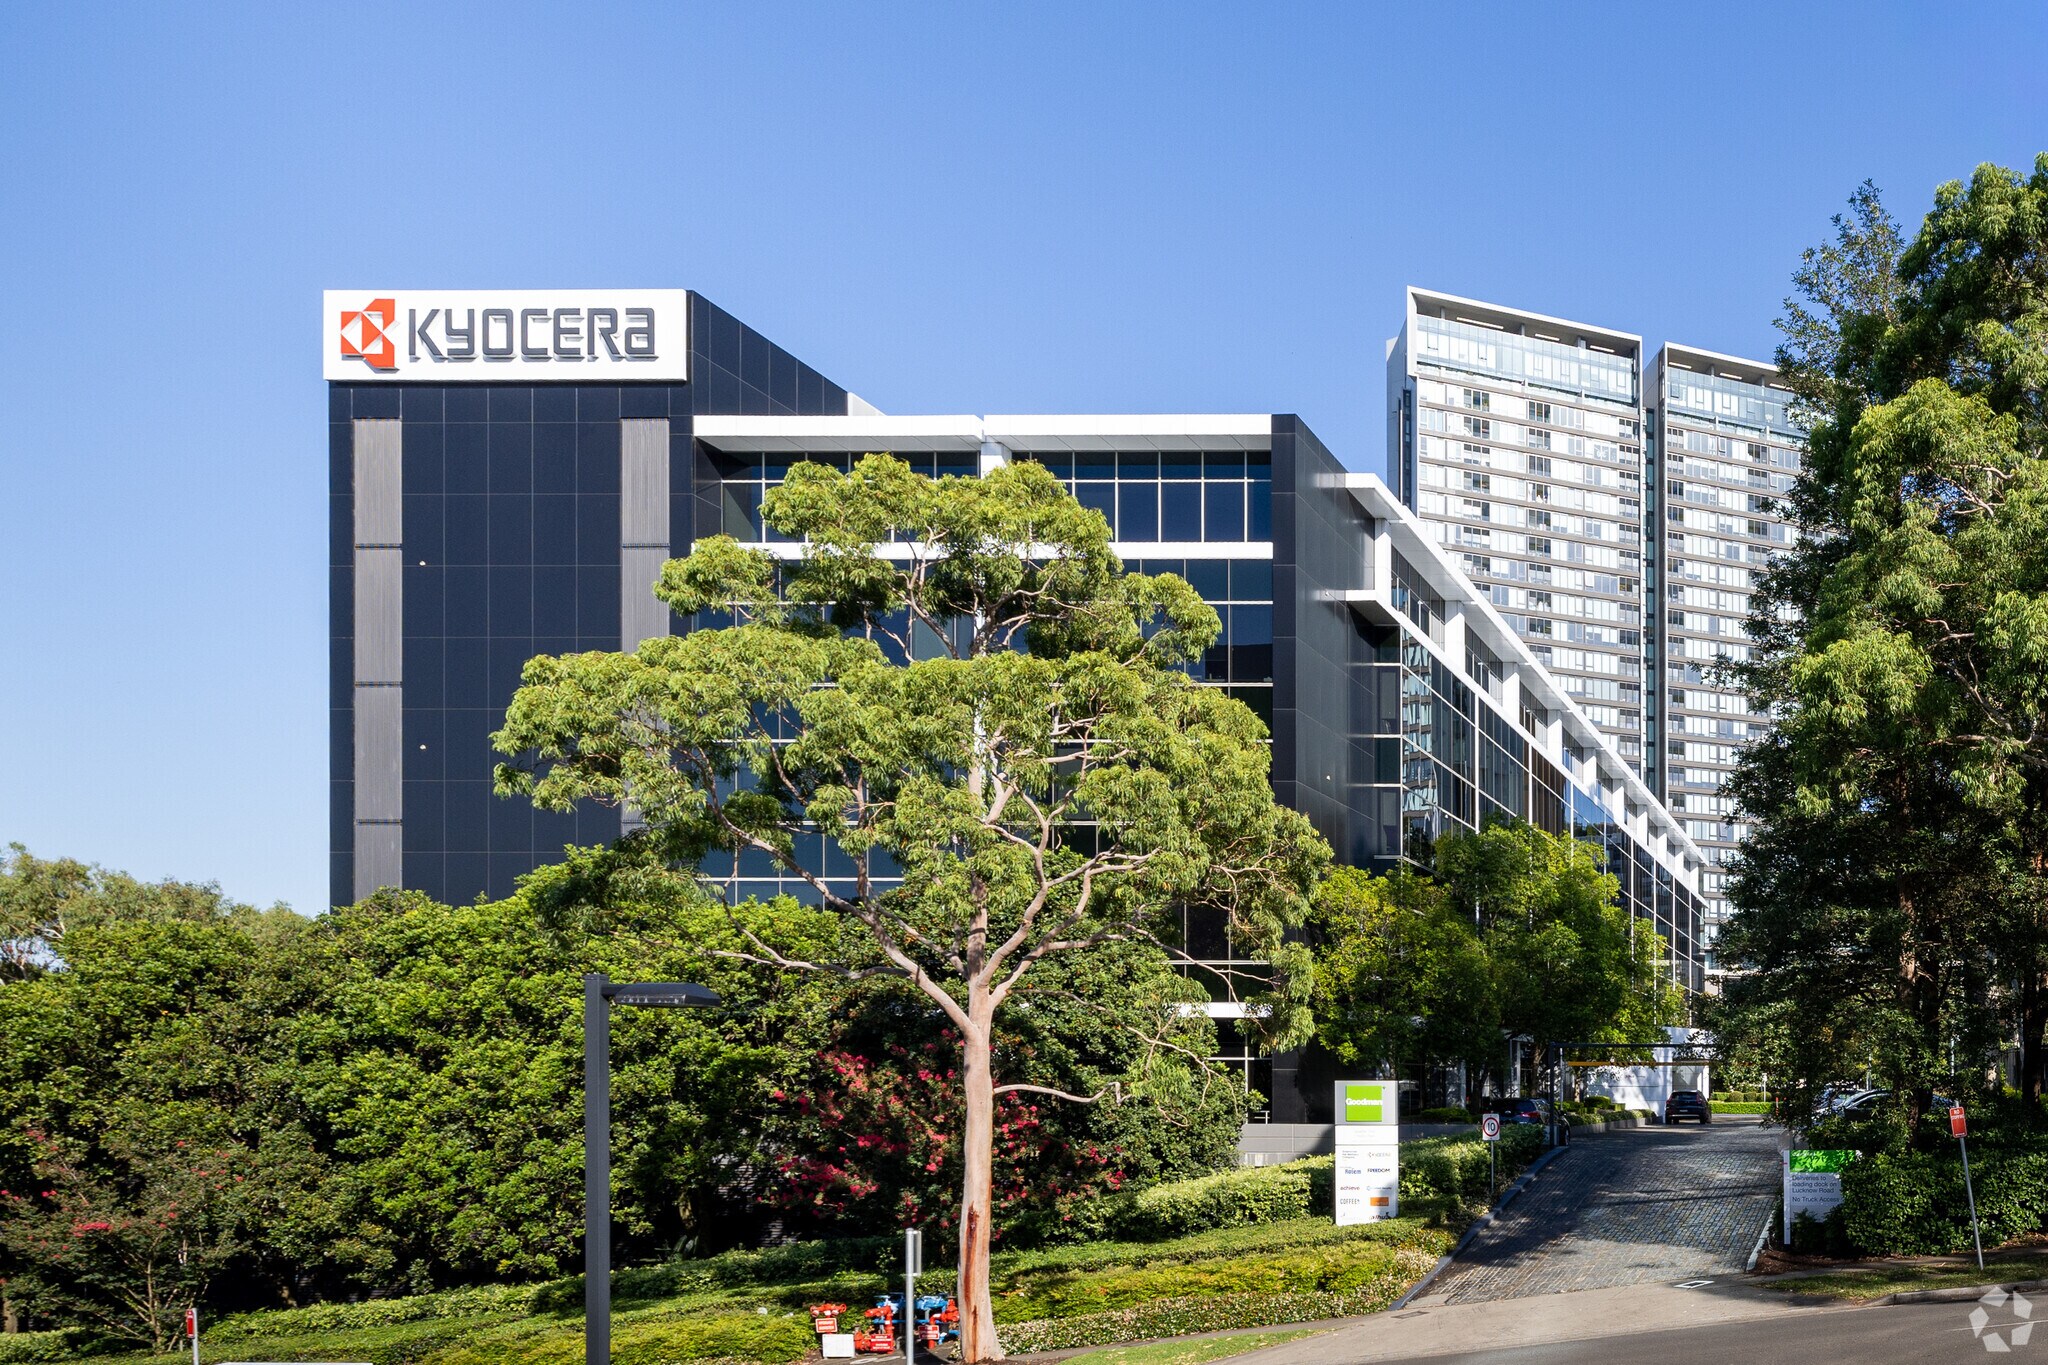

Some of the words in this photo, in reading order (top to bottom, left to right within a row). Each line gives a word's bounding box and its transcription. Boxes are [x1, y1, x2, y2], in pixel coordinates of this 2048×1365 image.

[408, 307, 656, 357] KYOCERA
[1345, 1097, 1383, 1105] Goodman
[1487, 1123, 1496, 1131] 10
